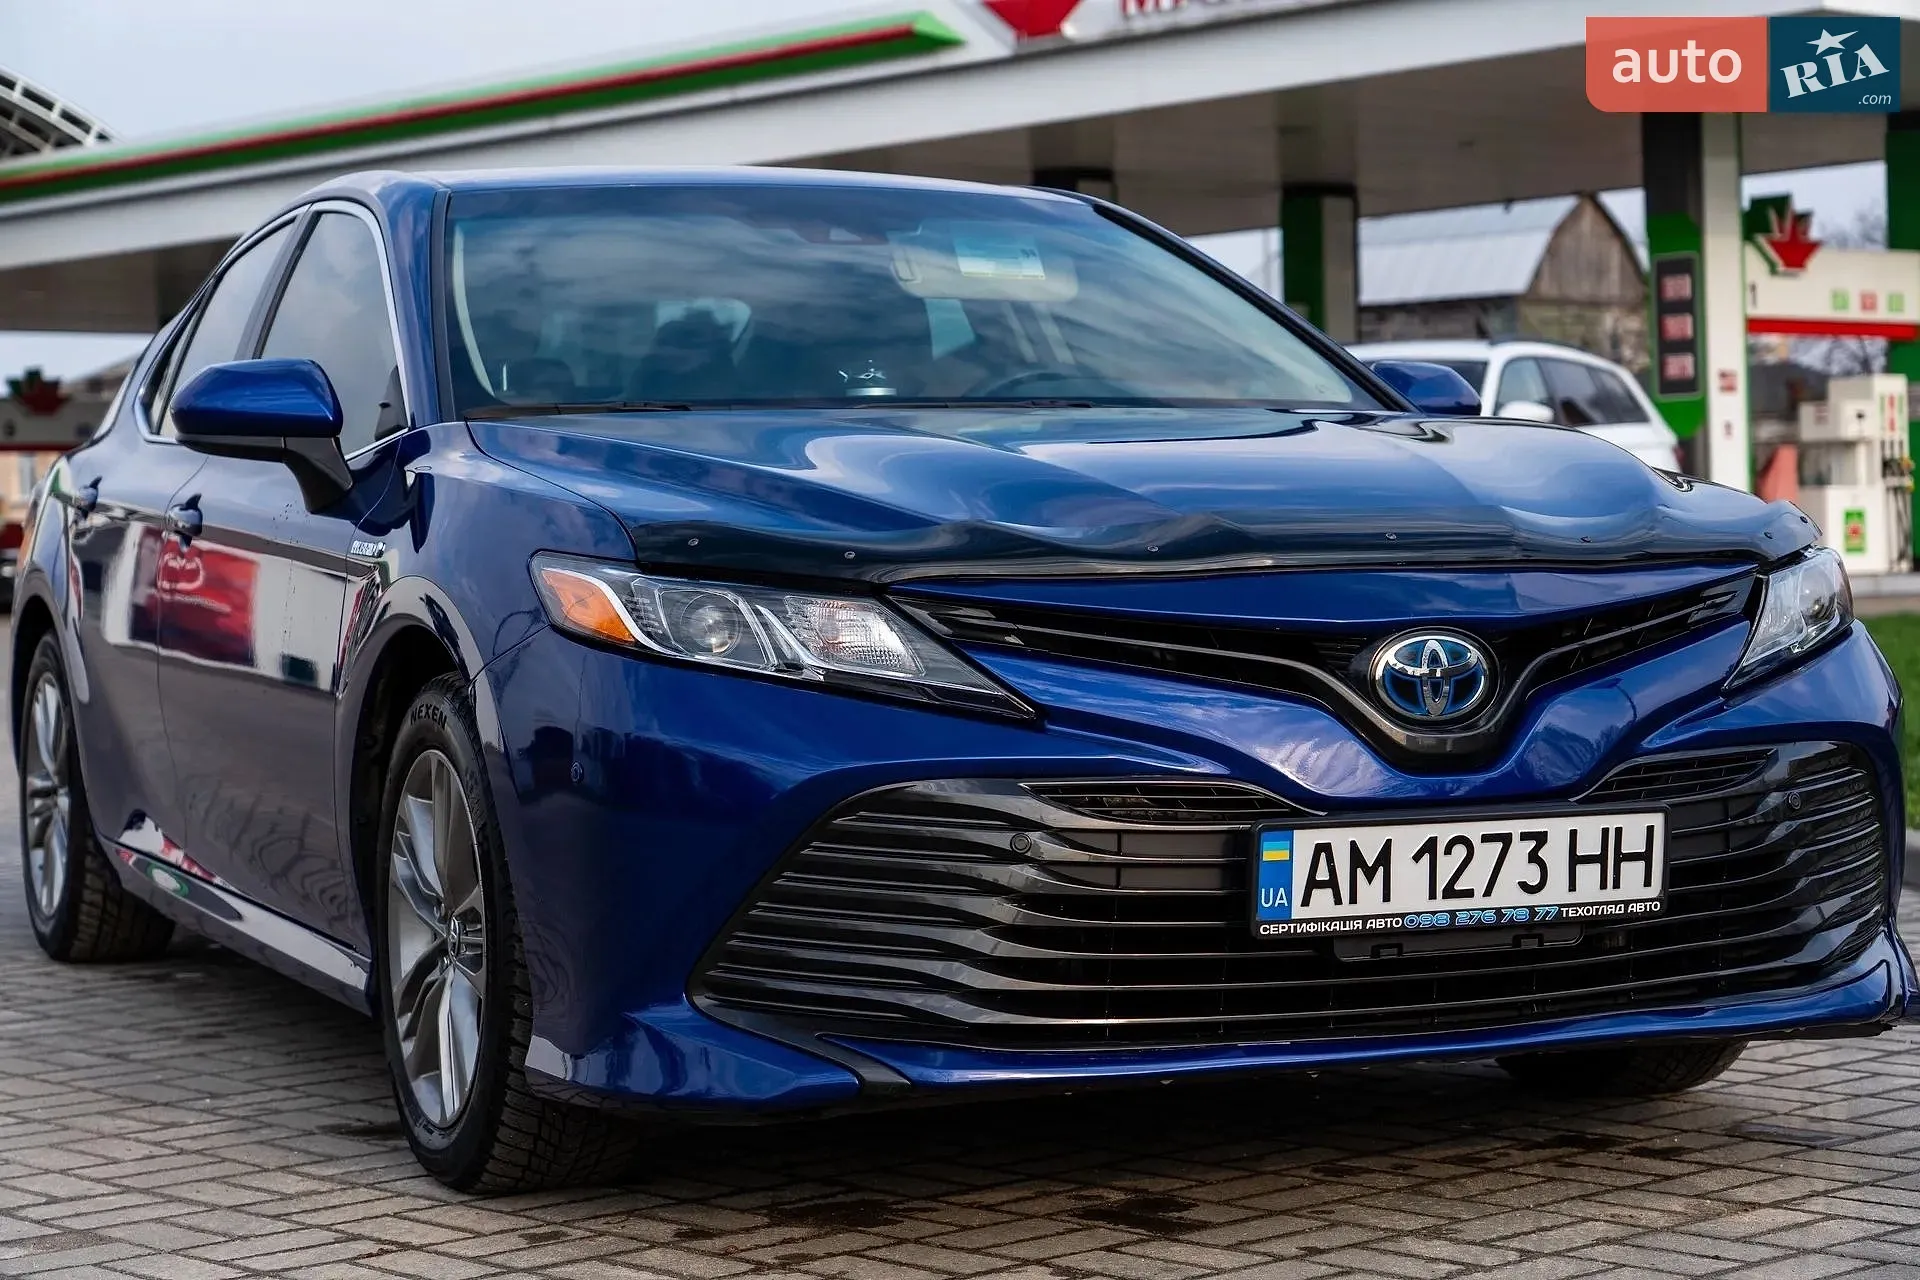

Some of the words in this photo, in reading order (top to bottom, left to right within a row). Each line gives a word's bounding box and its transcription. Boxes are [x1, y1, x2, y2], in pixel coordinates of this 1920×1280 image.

[410, 703, 447, 731] NEXEN
[1300, 838, 1393, 907] AM
[1411, 830, 1549, 900] 1273
[1568, 825, 1656, 892] HH
[1260, 888, 1288, 907] UA
[1259, 919, 1362, 935] СЕРТИФІКАЦІЯ
[1366, 916, 1403, 930] АВТО
[1404, 913, 1450, 928] 098
[1455, 909, 1497, 926] 276
[1501, 907, 1529, 923] 78
[1534, 905, 1559, 921] 77
[1561, 903, 1624, 918] ТЕХОГЛЯД
[1627, 901, 1661, 914] АВТО
